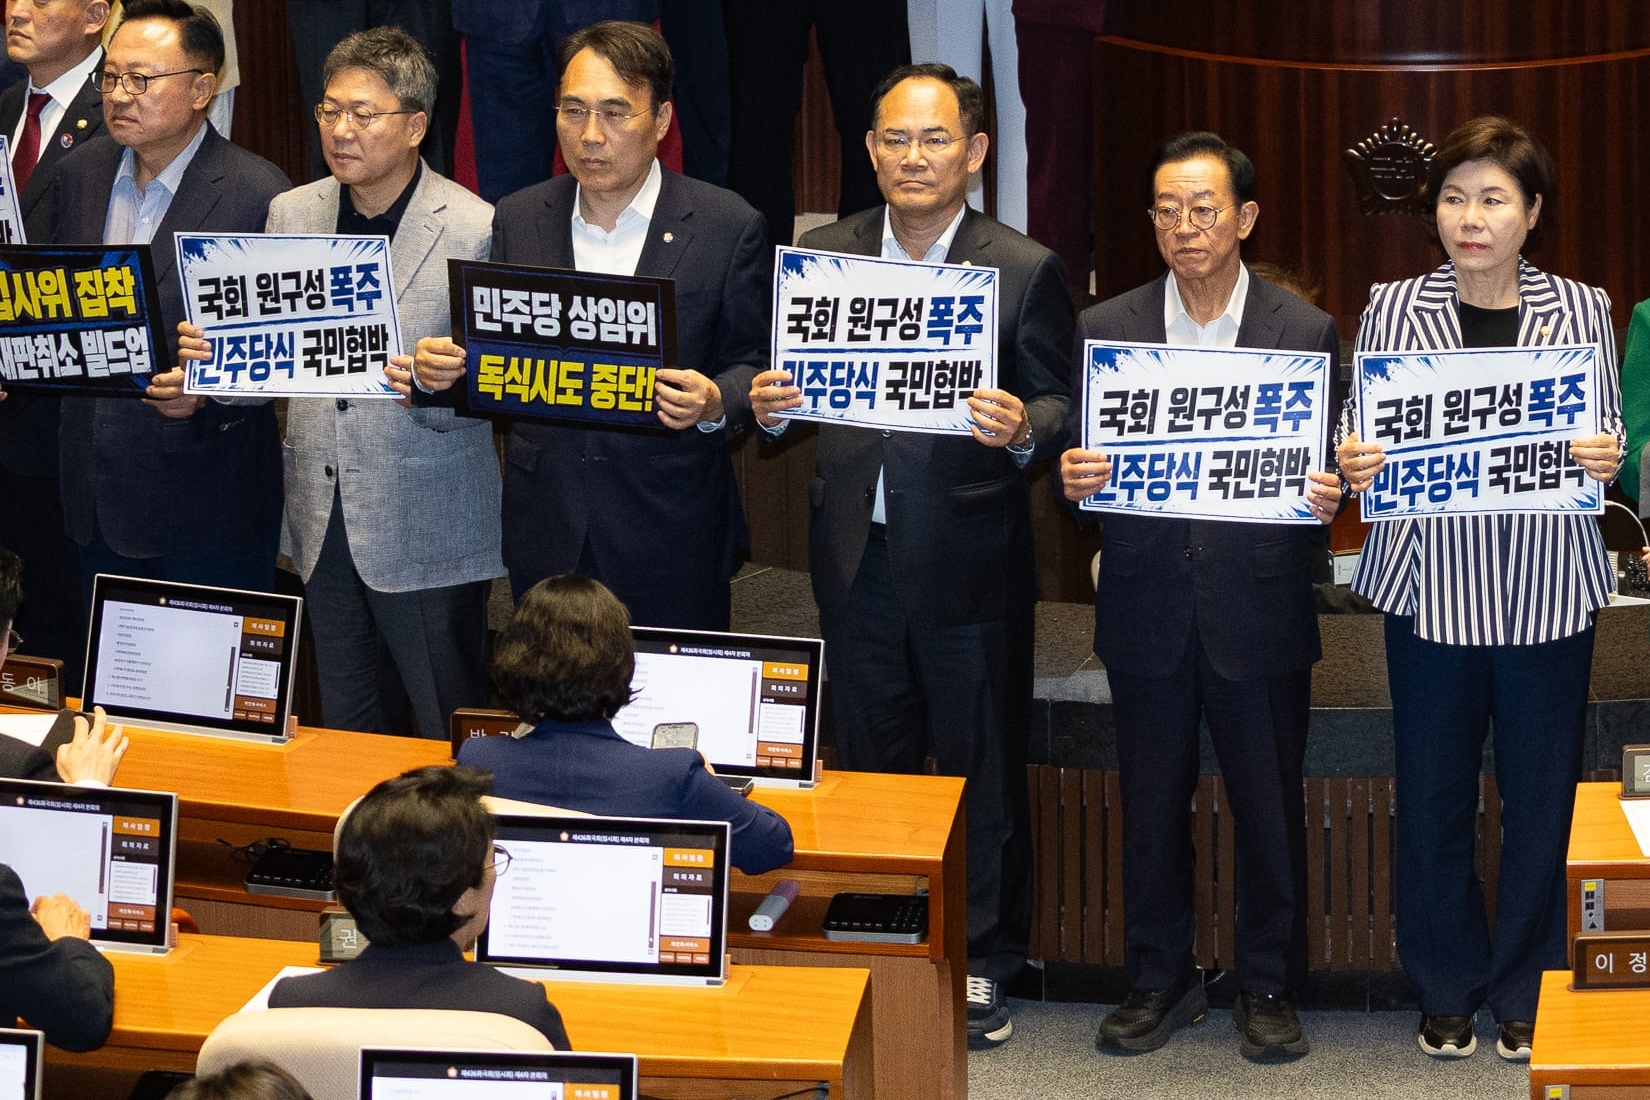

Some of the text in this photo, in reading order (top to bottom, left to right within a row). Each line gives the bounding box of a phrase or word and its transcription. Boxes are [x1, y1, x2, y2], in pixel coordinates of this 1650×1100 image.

[74, 266, 137, 319] 집착
[198, 262, 382, 320] 국회 원구성 폭주
[473, 285, 657, 347] 민주당 상임위
[787, 294, 984, 345] 국회 원구성 폭주
[84, 327, 151, 378] 빌드업
[199, 323, 389, 386] 민주당식 국민협박
[477, 355, 657, 414] 독식시도 중단!
[885, 358, 983, 411] 국민협박
[1099, 380, 1316, 437] 국회 원구성 폭주
[1373, 372, 1588, 444] 국회 원구성 폭주
[1208, 445, 1311, 500] 국민협박
[1373, 451, 1480, 514] 민주당식
